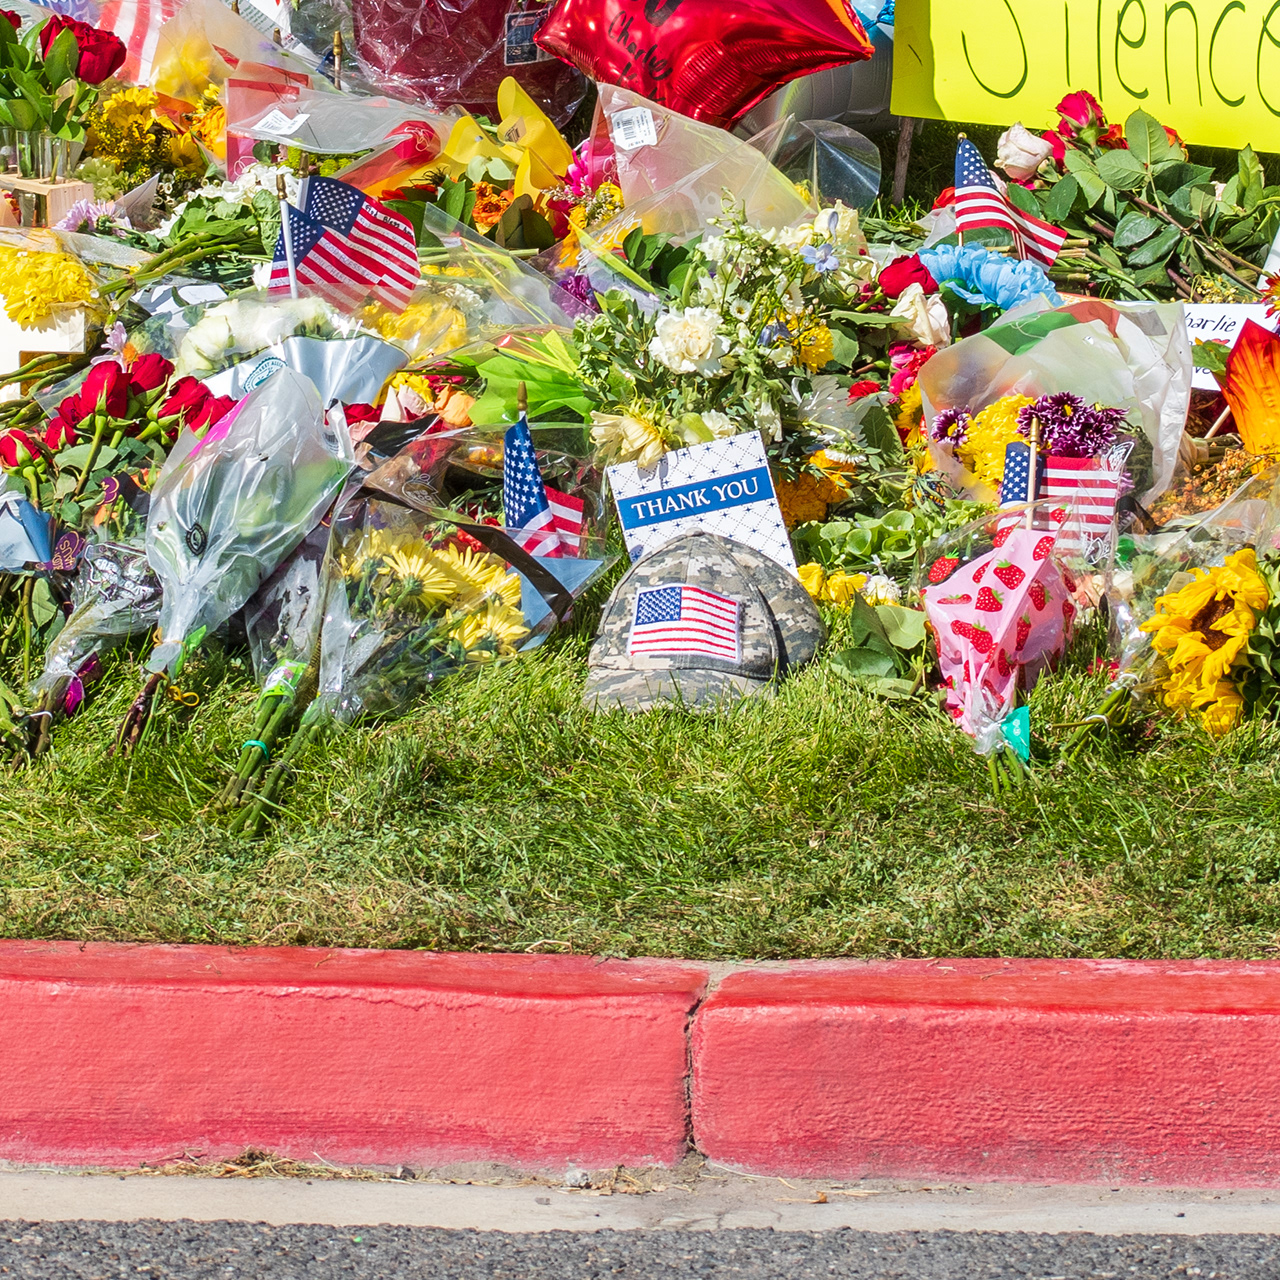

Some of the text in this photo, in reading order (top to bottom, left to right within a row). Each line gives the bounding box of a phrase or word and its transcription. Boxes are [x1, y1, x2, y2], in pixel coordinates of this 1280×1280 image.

[607, 9, 673, 82] Charlie
[630, 476, 760, 520] THANK YOU
